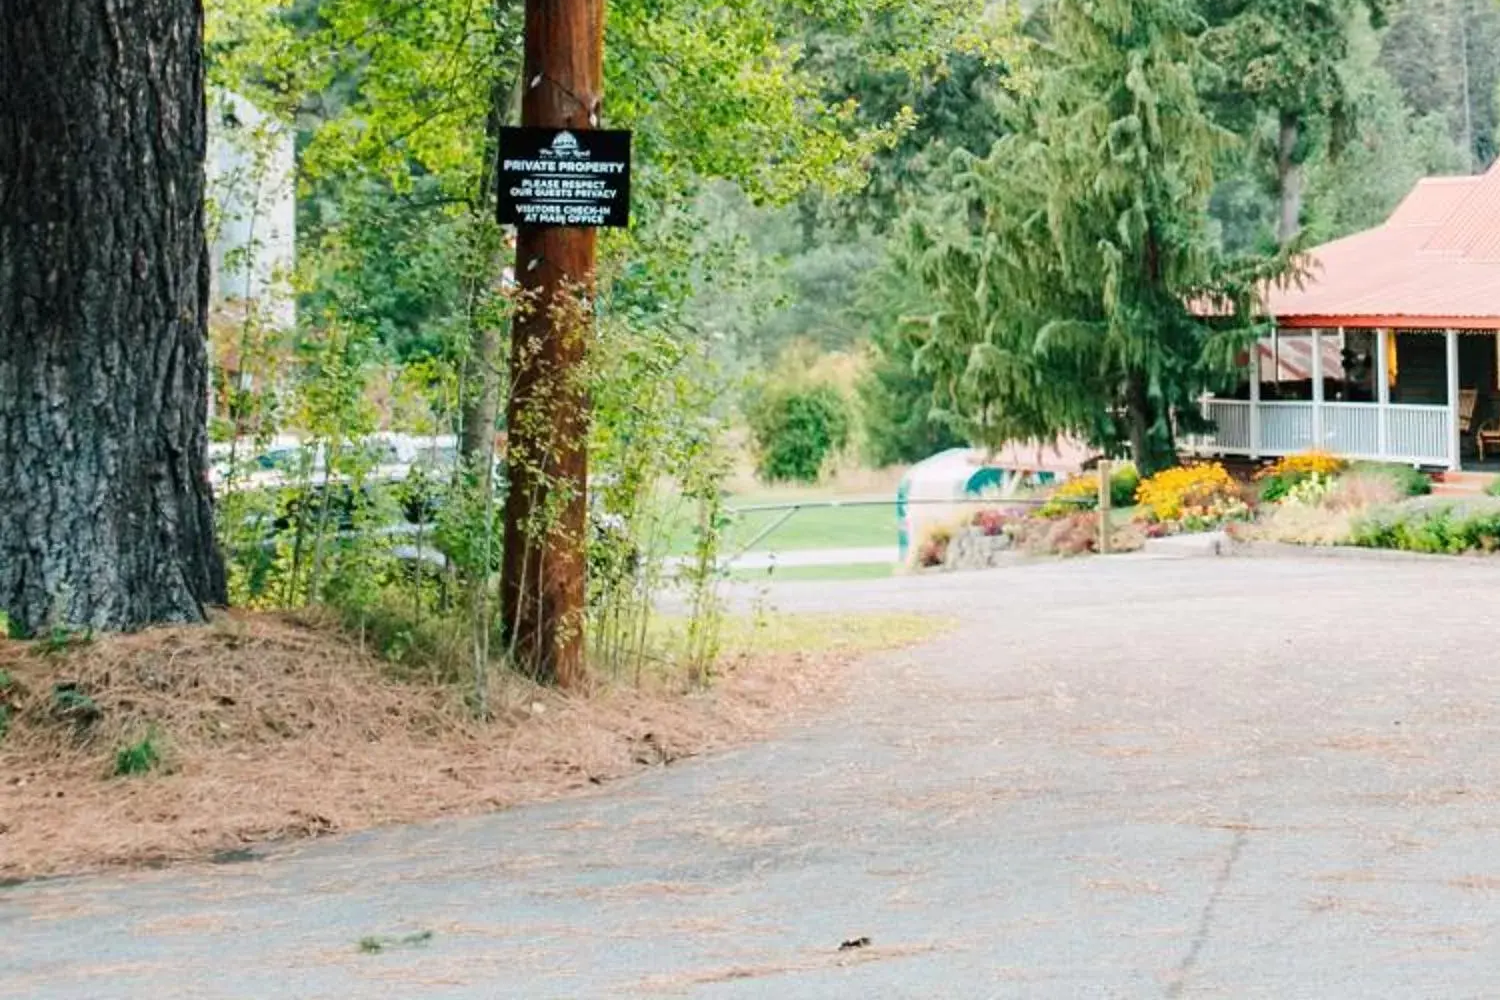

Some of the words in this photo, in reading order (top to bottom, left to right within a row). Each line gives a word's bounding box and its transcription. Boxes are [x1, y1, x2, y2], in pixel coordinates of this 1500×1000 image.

[503, 159, 556, 172] PRIVATE
[558, 160, 625, 173] PROPERTY
[521, 179, 559, 189] PLEASE
[561, 180, 607, 189] RESPECT
[509, 187, 533, 197] OUR
[574, 189, 617, 199] PRIVACY
[515, 204, 561, 214] VISITORS
[563, 205, 611, 215] CHECK-IN
[524, 213, 538, 222] AT
[539, 214, 566, 223] MAIN
[567, 215, 605, 224] OFFICE
